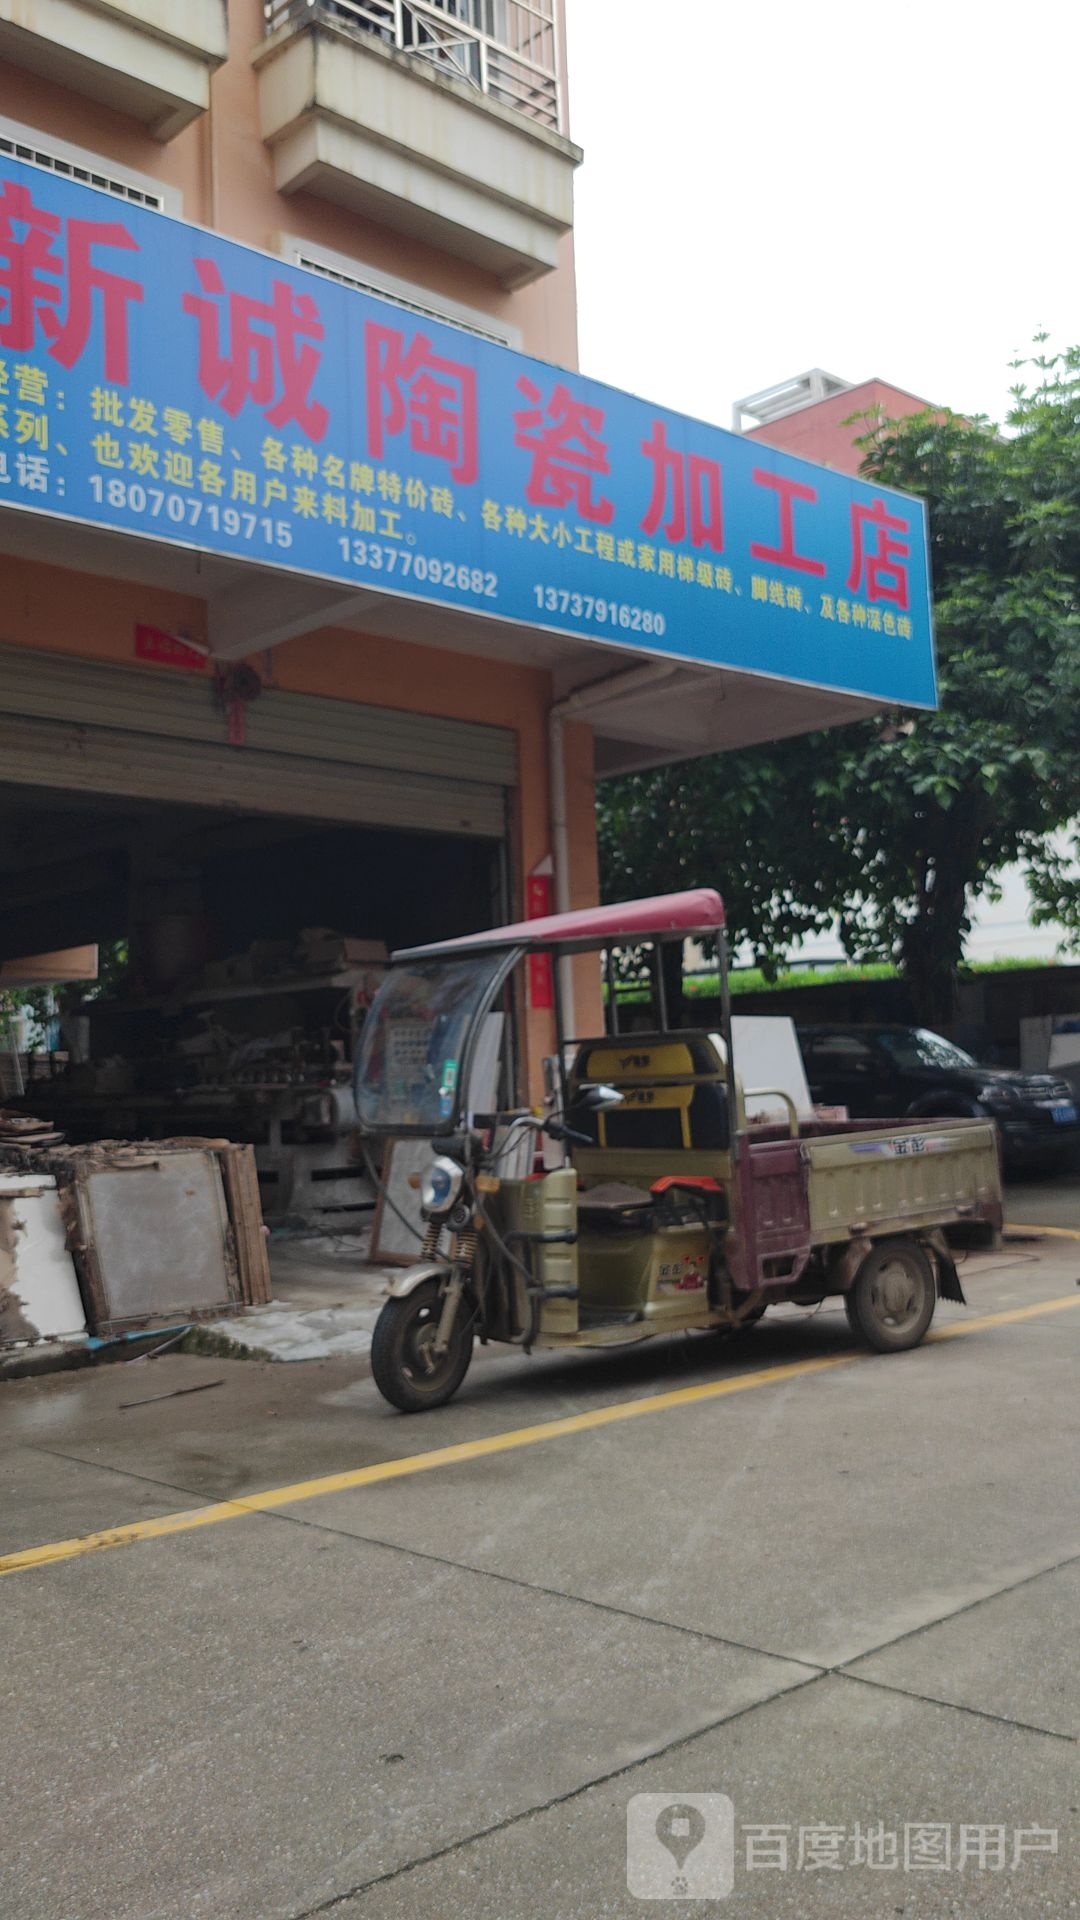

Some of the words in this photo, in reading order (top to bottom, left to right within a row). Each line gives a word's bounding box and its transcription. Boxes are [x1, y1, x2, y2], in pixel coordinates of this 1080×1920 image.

[0, 402, 417, 546] 列、也欢迎各用户来料加工。
[88, 474, 293, 549] 18070719715
[338, 536, 499, 598] 13377092682
[533, 585, 666, 636] 13737916280
